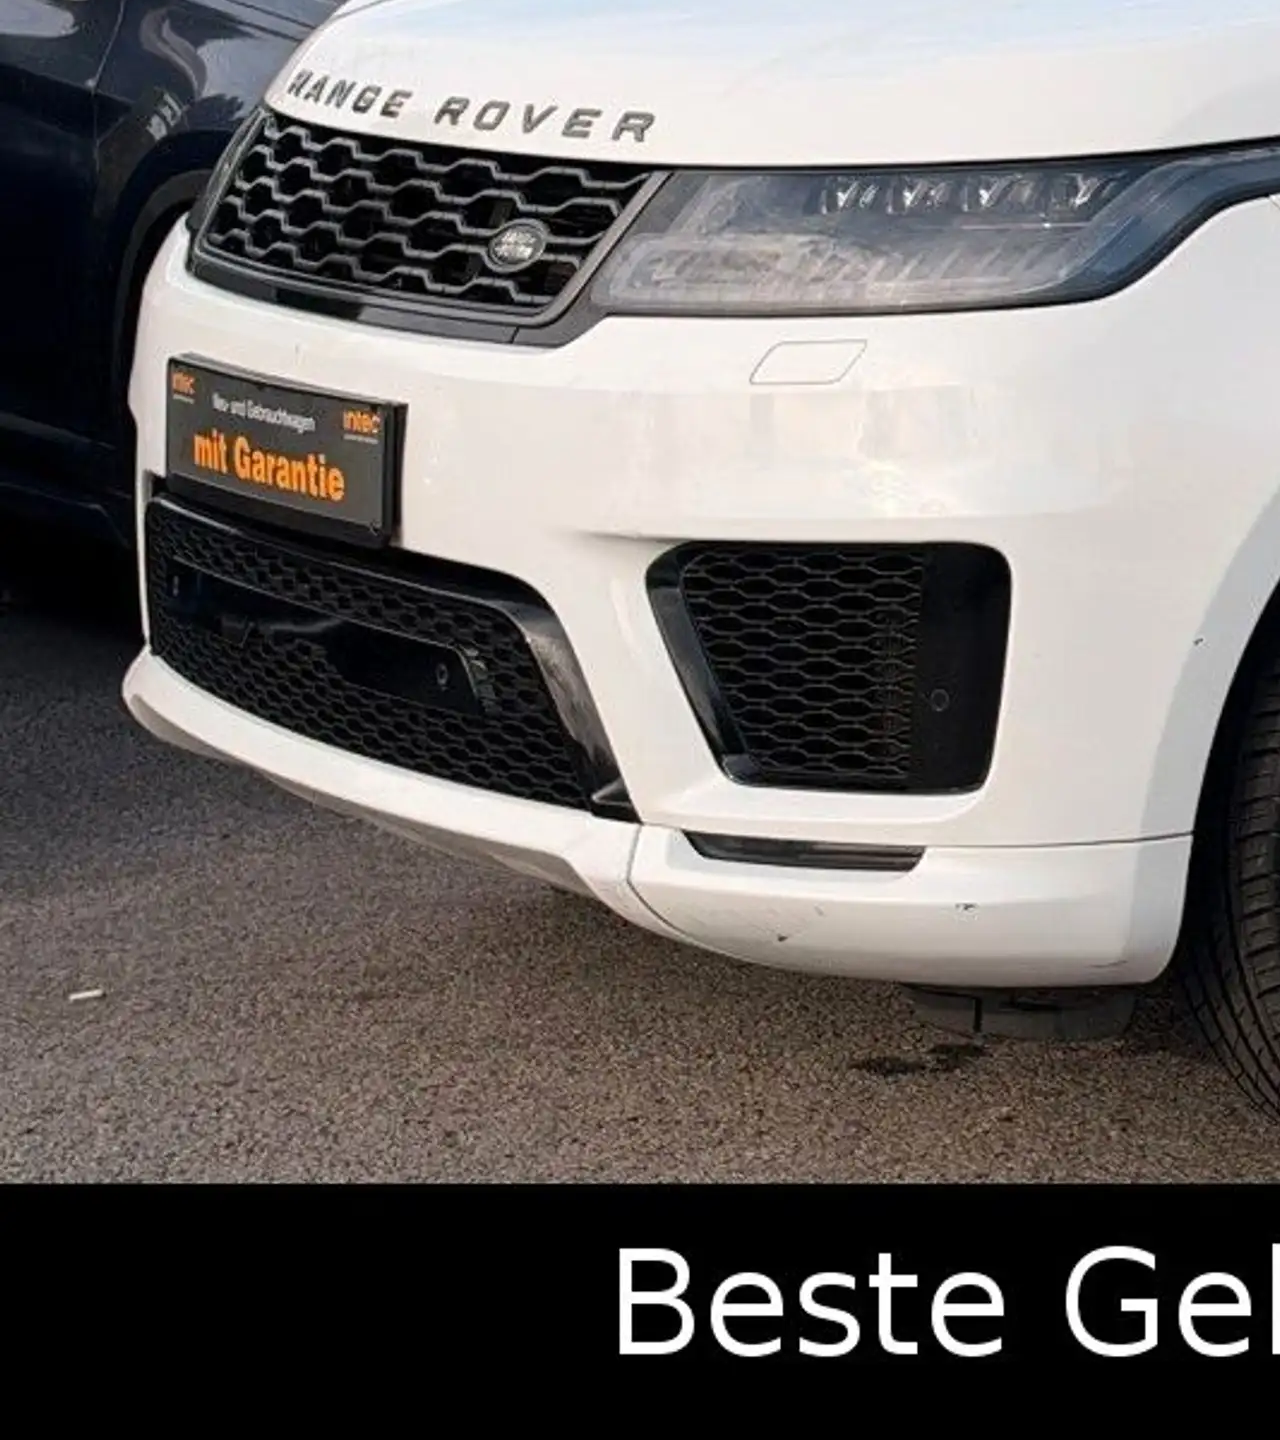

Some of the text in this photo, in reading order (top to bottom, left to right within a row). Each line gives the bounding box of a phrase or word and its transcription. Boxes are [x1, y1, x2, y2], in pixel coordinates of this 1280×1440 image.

[287, 70, 655, 142] RANGE ROVER
[193, 428, 345, 501] mit Garantie
